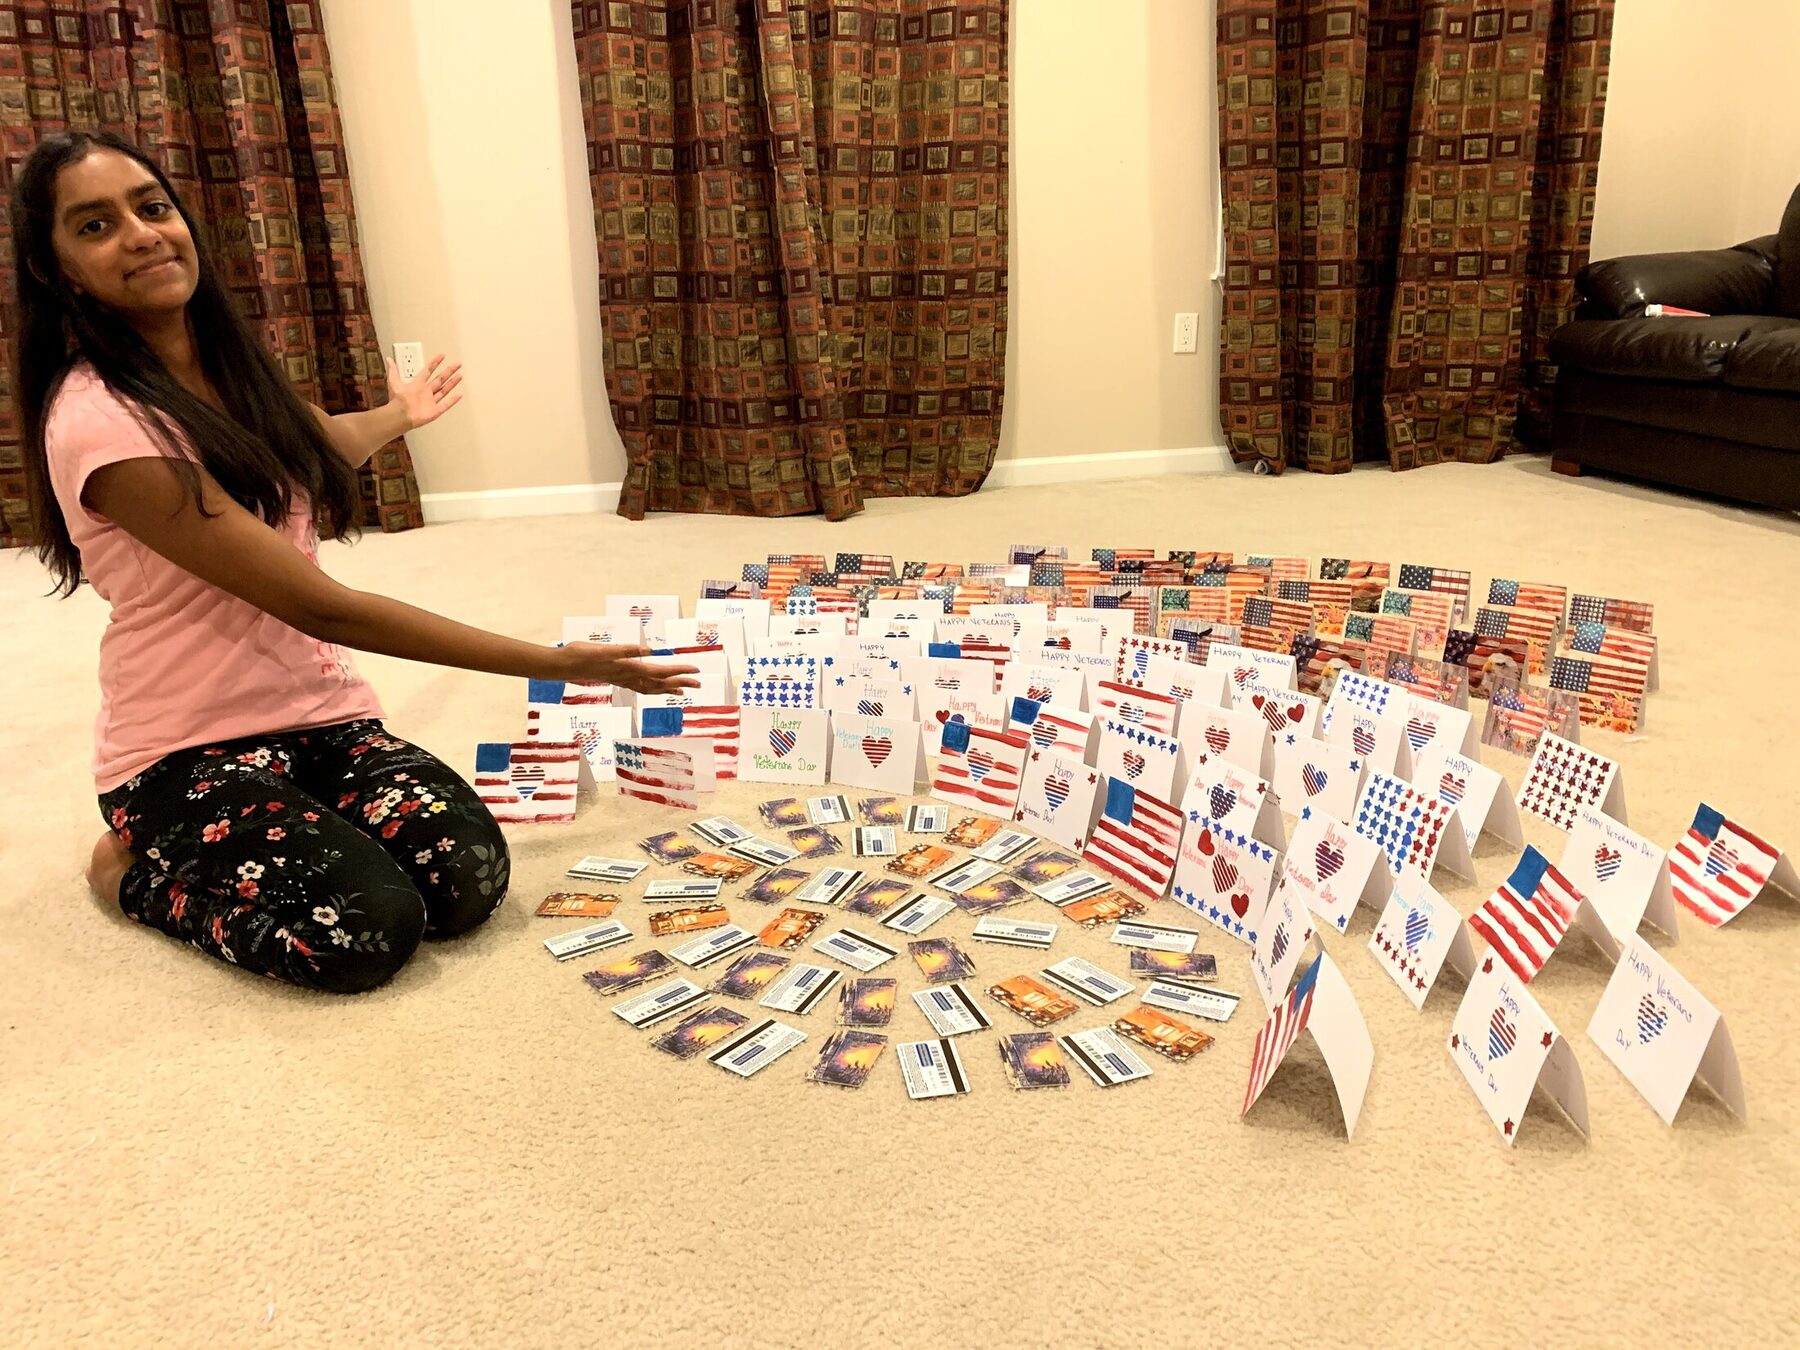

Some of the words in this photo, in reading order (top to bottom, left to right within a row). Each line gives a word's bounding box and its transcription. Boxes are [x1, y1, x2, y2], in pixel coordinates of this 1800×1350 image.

[939, 617, 966, 626] HAPPY
[970, 616, 1012, 626] VETERANS
[859, 643, 885, 652] HAPPY
[1041, 651, 1070, 662] HAPPY
[1074, 654, 1112, 667] VETERANS
[1214, 647, 1242, 659] HAPPY
[1252, 653, 1290, 666] VETERANS
[1232, 694, 1242, 703] AY
[1246, 681, 1270, 697] HAPPY
[1273, 688, 1309, 704] VETERANS
[771, 712, 802, 729] Happy
[865, 720, 894, 737] Happy
[1353, 715, 1376, 732] HAPPY
[753, 754, 793, 770] Veterans
[797, 757, 817, 771] Day
[1053, 758, 1075, 781] Happy
[1445, 756, 1473, 776] HAPPY
[1583, 810, 1603, 830] HAPPY
[1656, 974, 1693, 1023] Veterans
